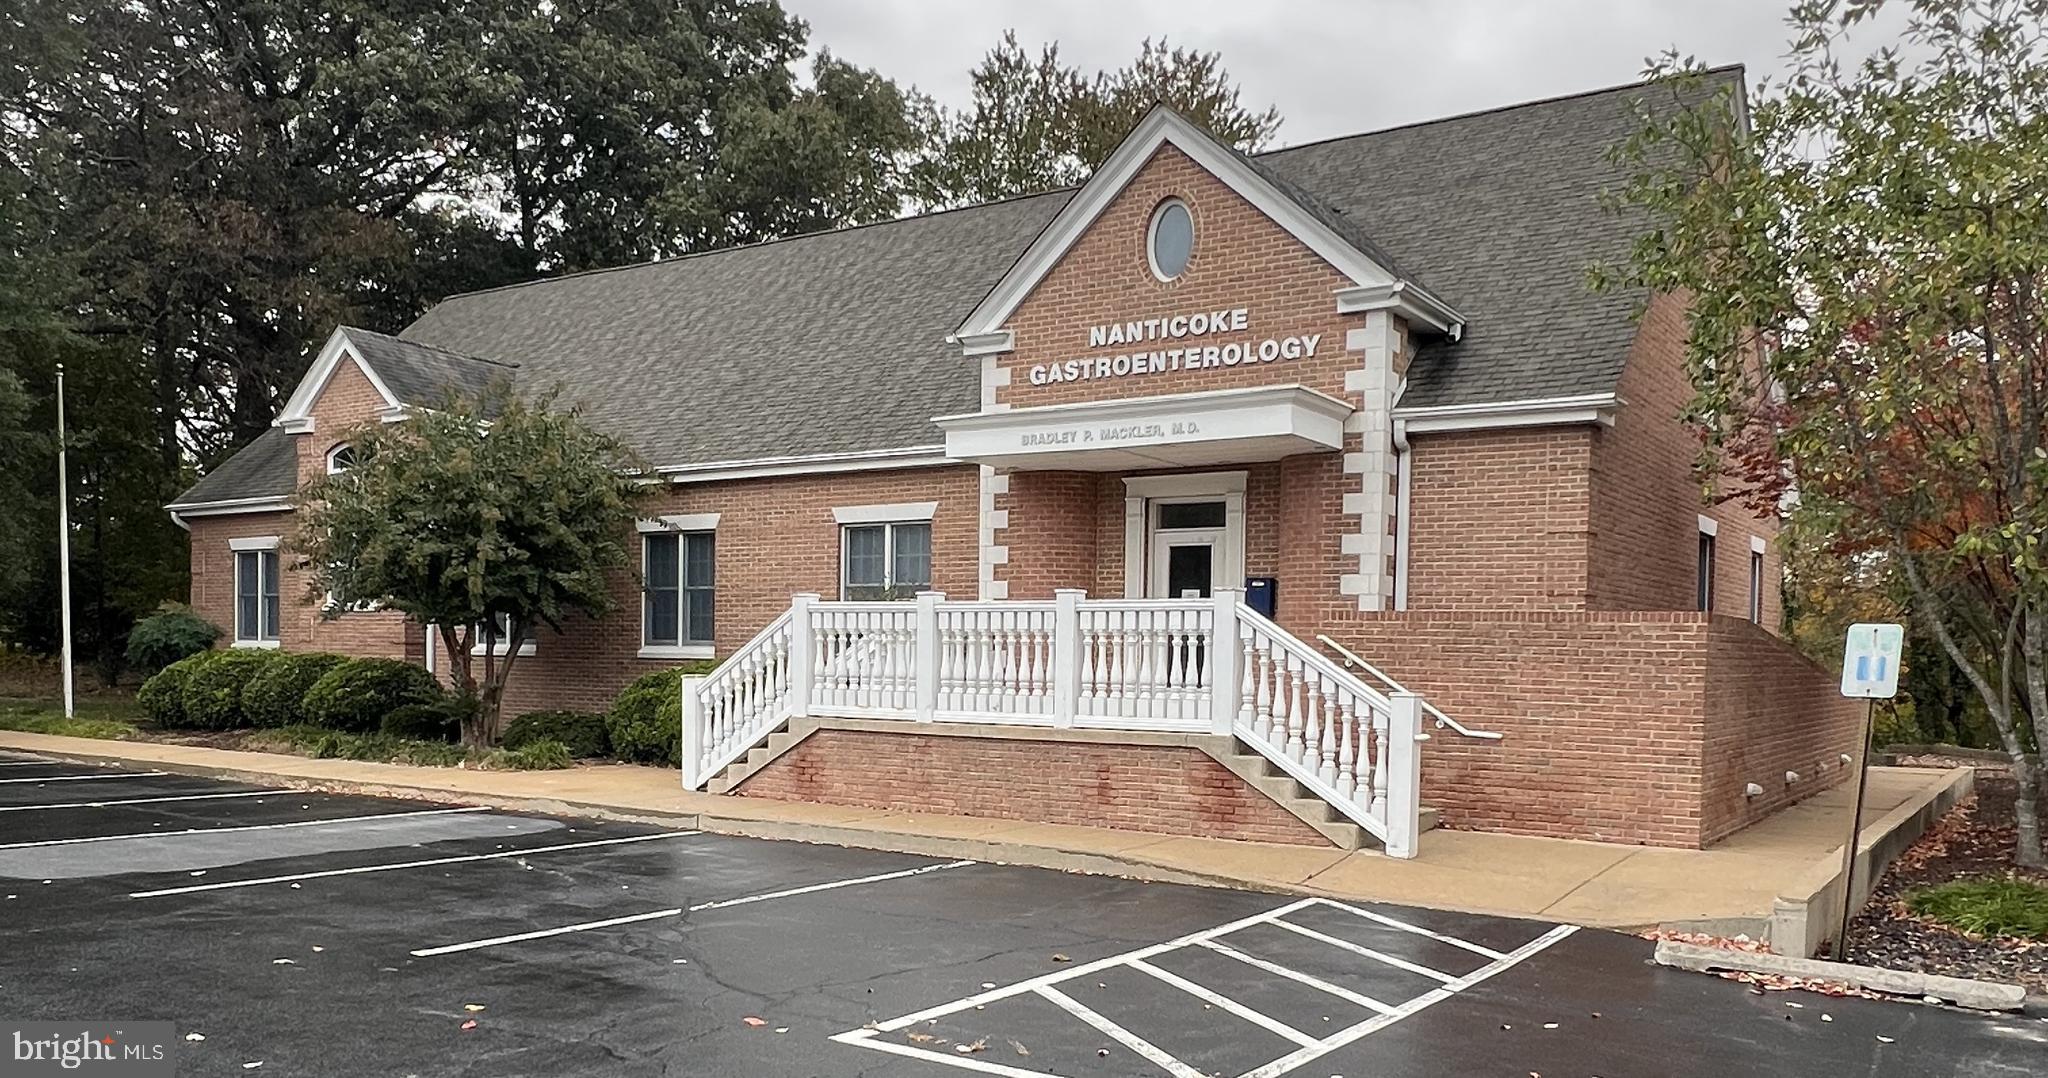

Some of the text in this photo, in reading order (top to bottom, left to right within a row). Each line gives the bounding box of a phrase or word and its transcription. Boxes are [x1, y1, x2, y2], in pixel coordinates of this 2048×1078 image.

[1090, 309, 1248, 347] NANTICOKE
[1029, 335, 1321, 386] GASTROENTEROLOGY
[1021, 431, 1077, 447] BRADLEY
[1083, 428, 1094, 442] P.
[1100, 424, 1165, 441] MACKLER,
